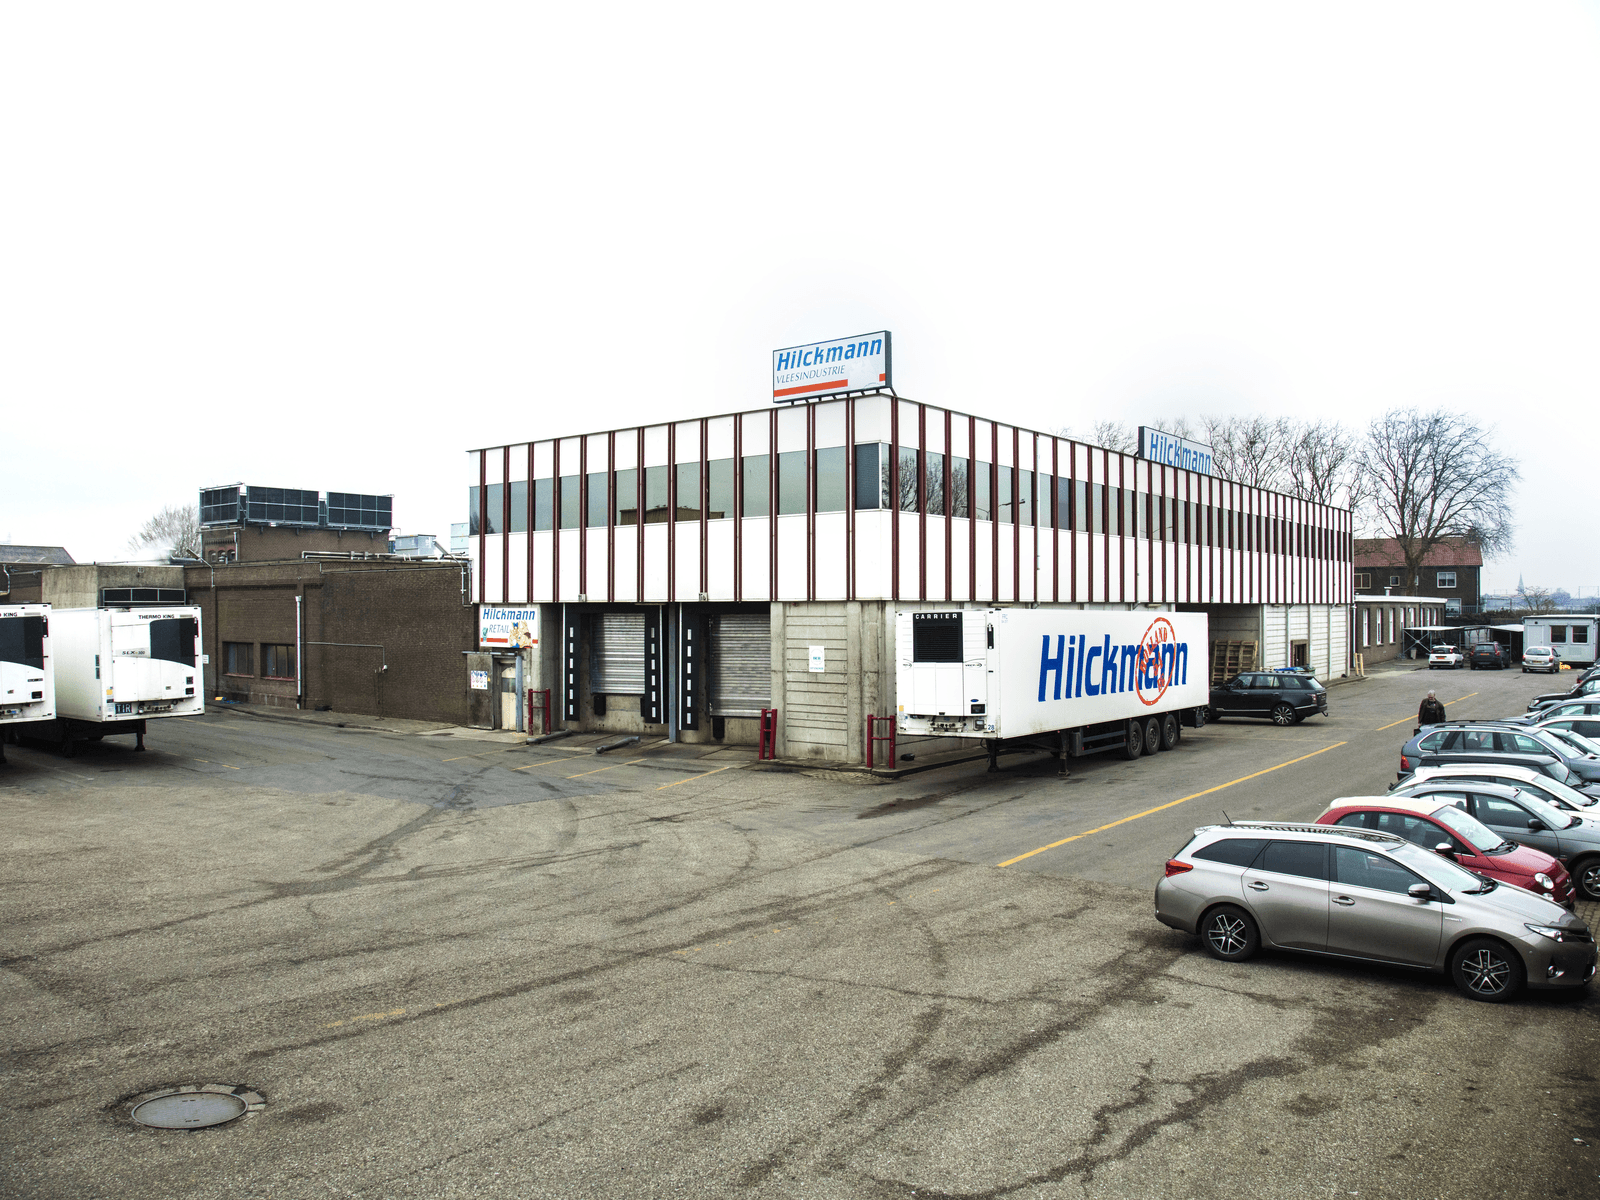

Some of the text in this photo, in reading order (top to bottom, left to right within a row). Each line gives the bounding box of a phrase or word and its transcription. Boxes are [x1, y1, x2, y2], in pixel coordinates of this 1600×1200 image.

[777, 339, 882, 371] Hilckmann
[776, 365, 845, 384] VLEESINDUSTRIE
[1150, 433, 1211, 475] Hilckmann
[483, 609, 535, 620] Hilckmann
[489, 624, 509, 633] RETAIL
[1038, 634, 1188, 702] Hilckmann
[116, 703, 131, 714] TIR
